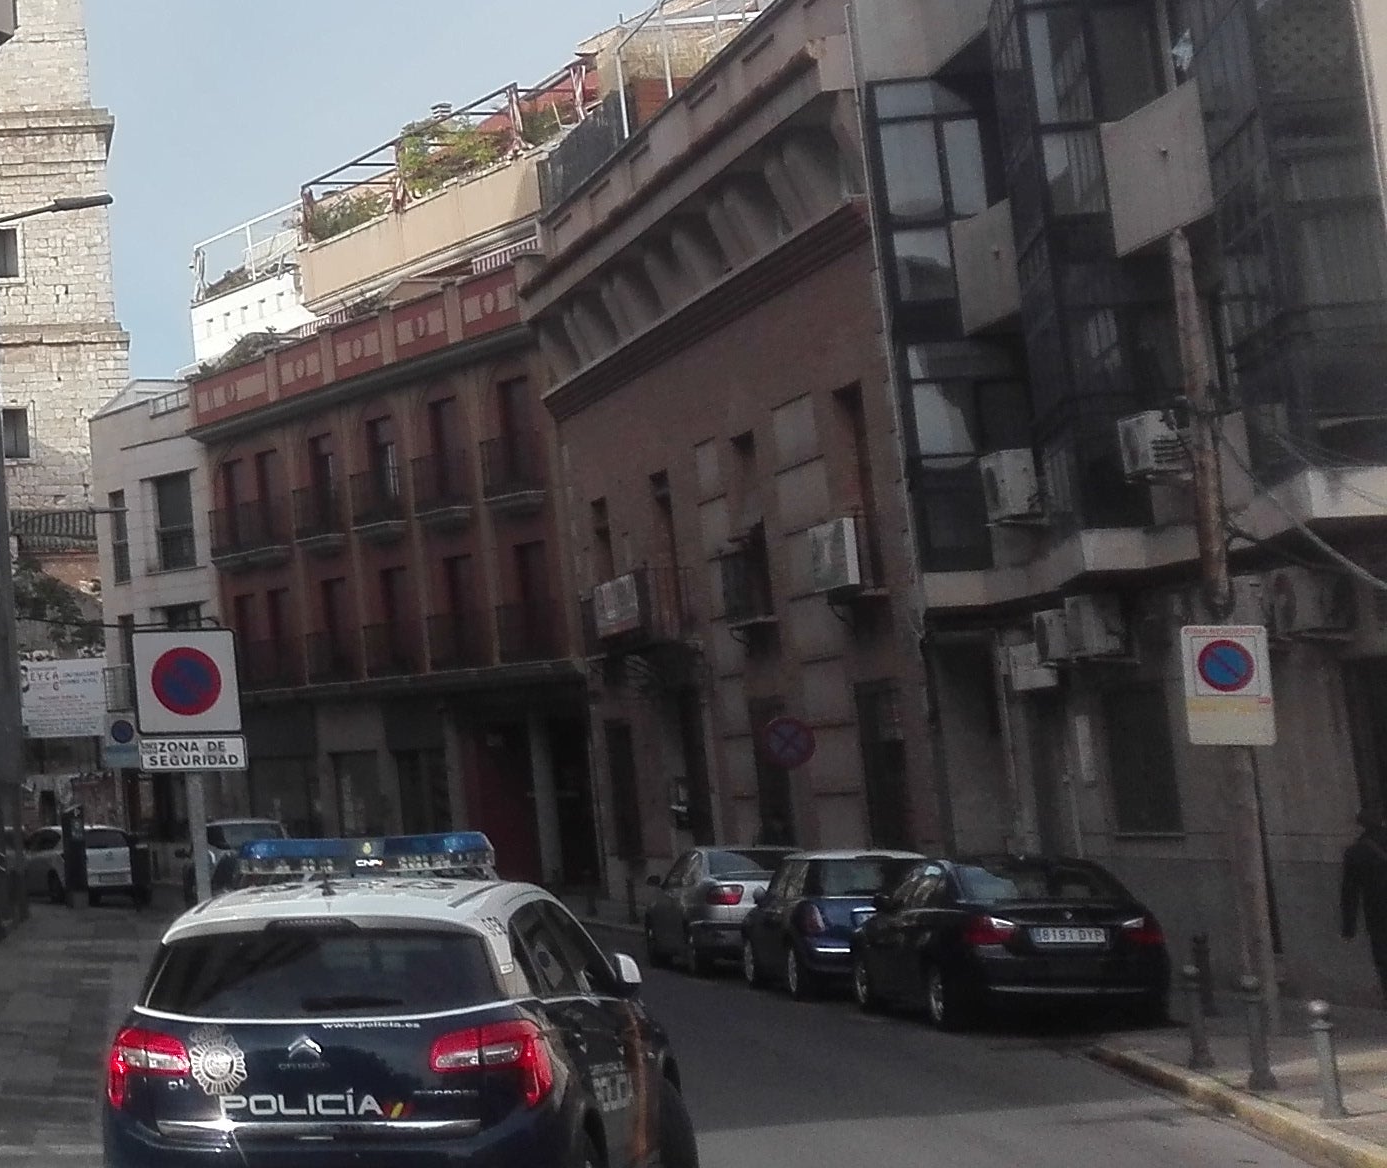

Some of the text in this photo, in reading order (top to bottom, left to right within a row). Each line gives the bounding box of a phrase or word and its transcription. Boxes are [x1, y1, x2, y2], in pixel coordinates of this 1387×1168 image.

[158, 741, 199, 753] ZONA
[207, 741, 226, 752] DE
[149, 754, 239, 767] SEGURIDAD
[322, 1020, 421, 1030] www.policia.es
[219, 1087, 384, 1116] POLICÍA
